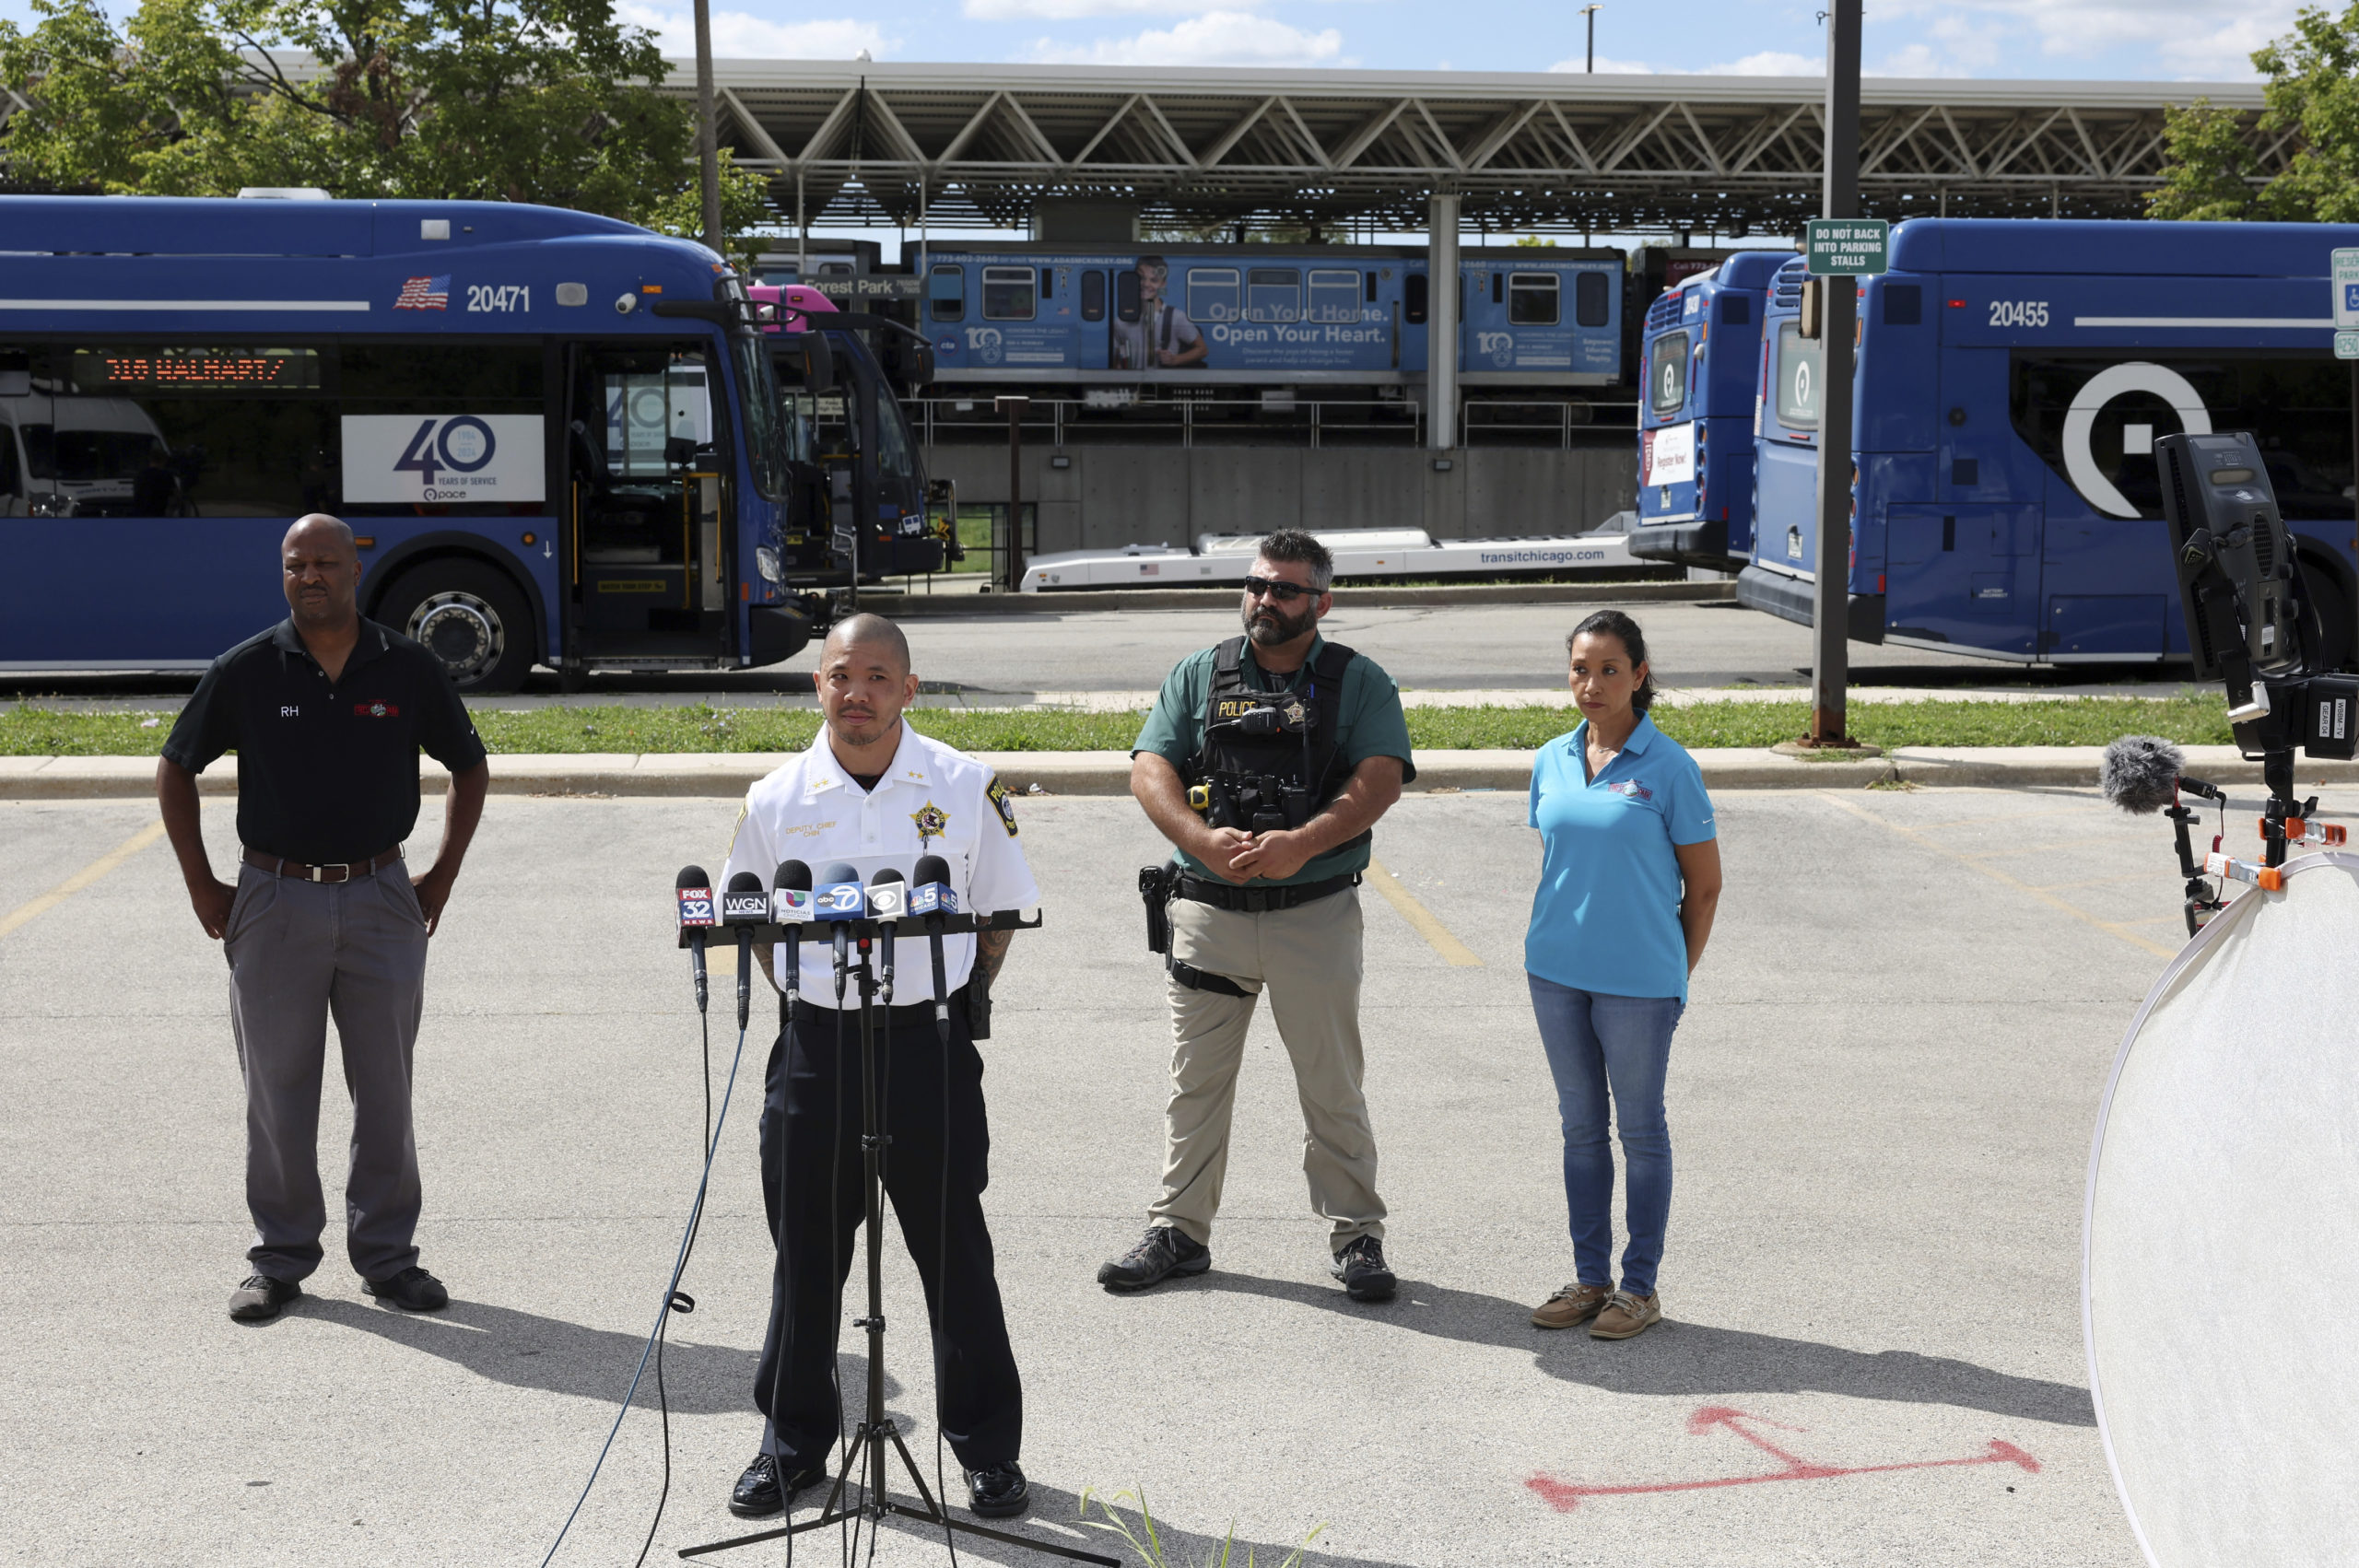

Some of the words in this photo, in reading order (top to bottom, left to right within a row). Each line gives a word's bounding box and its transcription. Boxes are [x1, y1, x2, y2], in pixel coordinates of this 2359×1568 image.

[1816, 228, 1829, 240] DO
[1832, 228, 1852, 240] NOT
[1854, 228, 1881, 240] BACK
[1814, 242, 1837, 253] INTO
[1840, 242, 1882, 253] PARKING
[1830, 255, 1866, 266] STALLS
[804, 278, 853, 294] Forest
[858, 279, 893, 294] Park
[466, 284, 530, 313] 20471
[1209, 302, 1264, 326] Open
[1270, 303, 1317, 321] Your
[1322, 303, 1390, 322] Home.
[1989, 300, 2049, 327] 20455
[1212, 323, 1268, 346] Open
[1273, 325, 1320, 343] Your
[1325, 325, 1387, 343] Heart.
[940, 341, 957, 350] cta
[393, 415, 496, 486] 40
[438, 477, 459, 486] YEARS
[461, 477, 468, 486] OF
[470, 477, 498, 486] SERVICE
[438, 490, 466, 500] pace
[1481, 550, 1605, 564] transitchicago.com
[280, 705, 299, 718] RH
[2321, 726, 2328, 734] 04
[785, 825, 814, 835] DEPUTY
[816, 821, 837, 830] CHIEF
[803, 829, 820, 837] CHIN
[682, 889, 709, 900] FOX
[924, 887, 937, 903] 5
[950, 893, 958, 907] 5
[683, 900, 710, 919] 32
[725, 897, 767, 911] WGN
